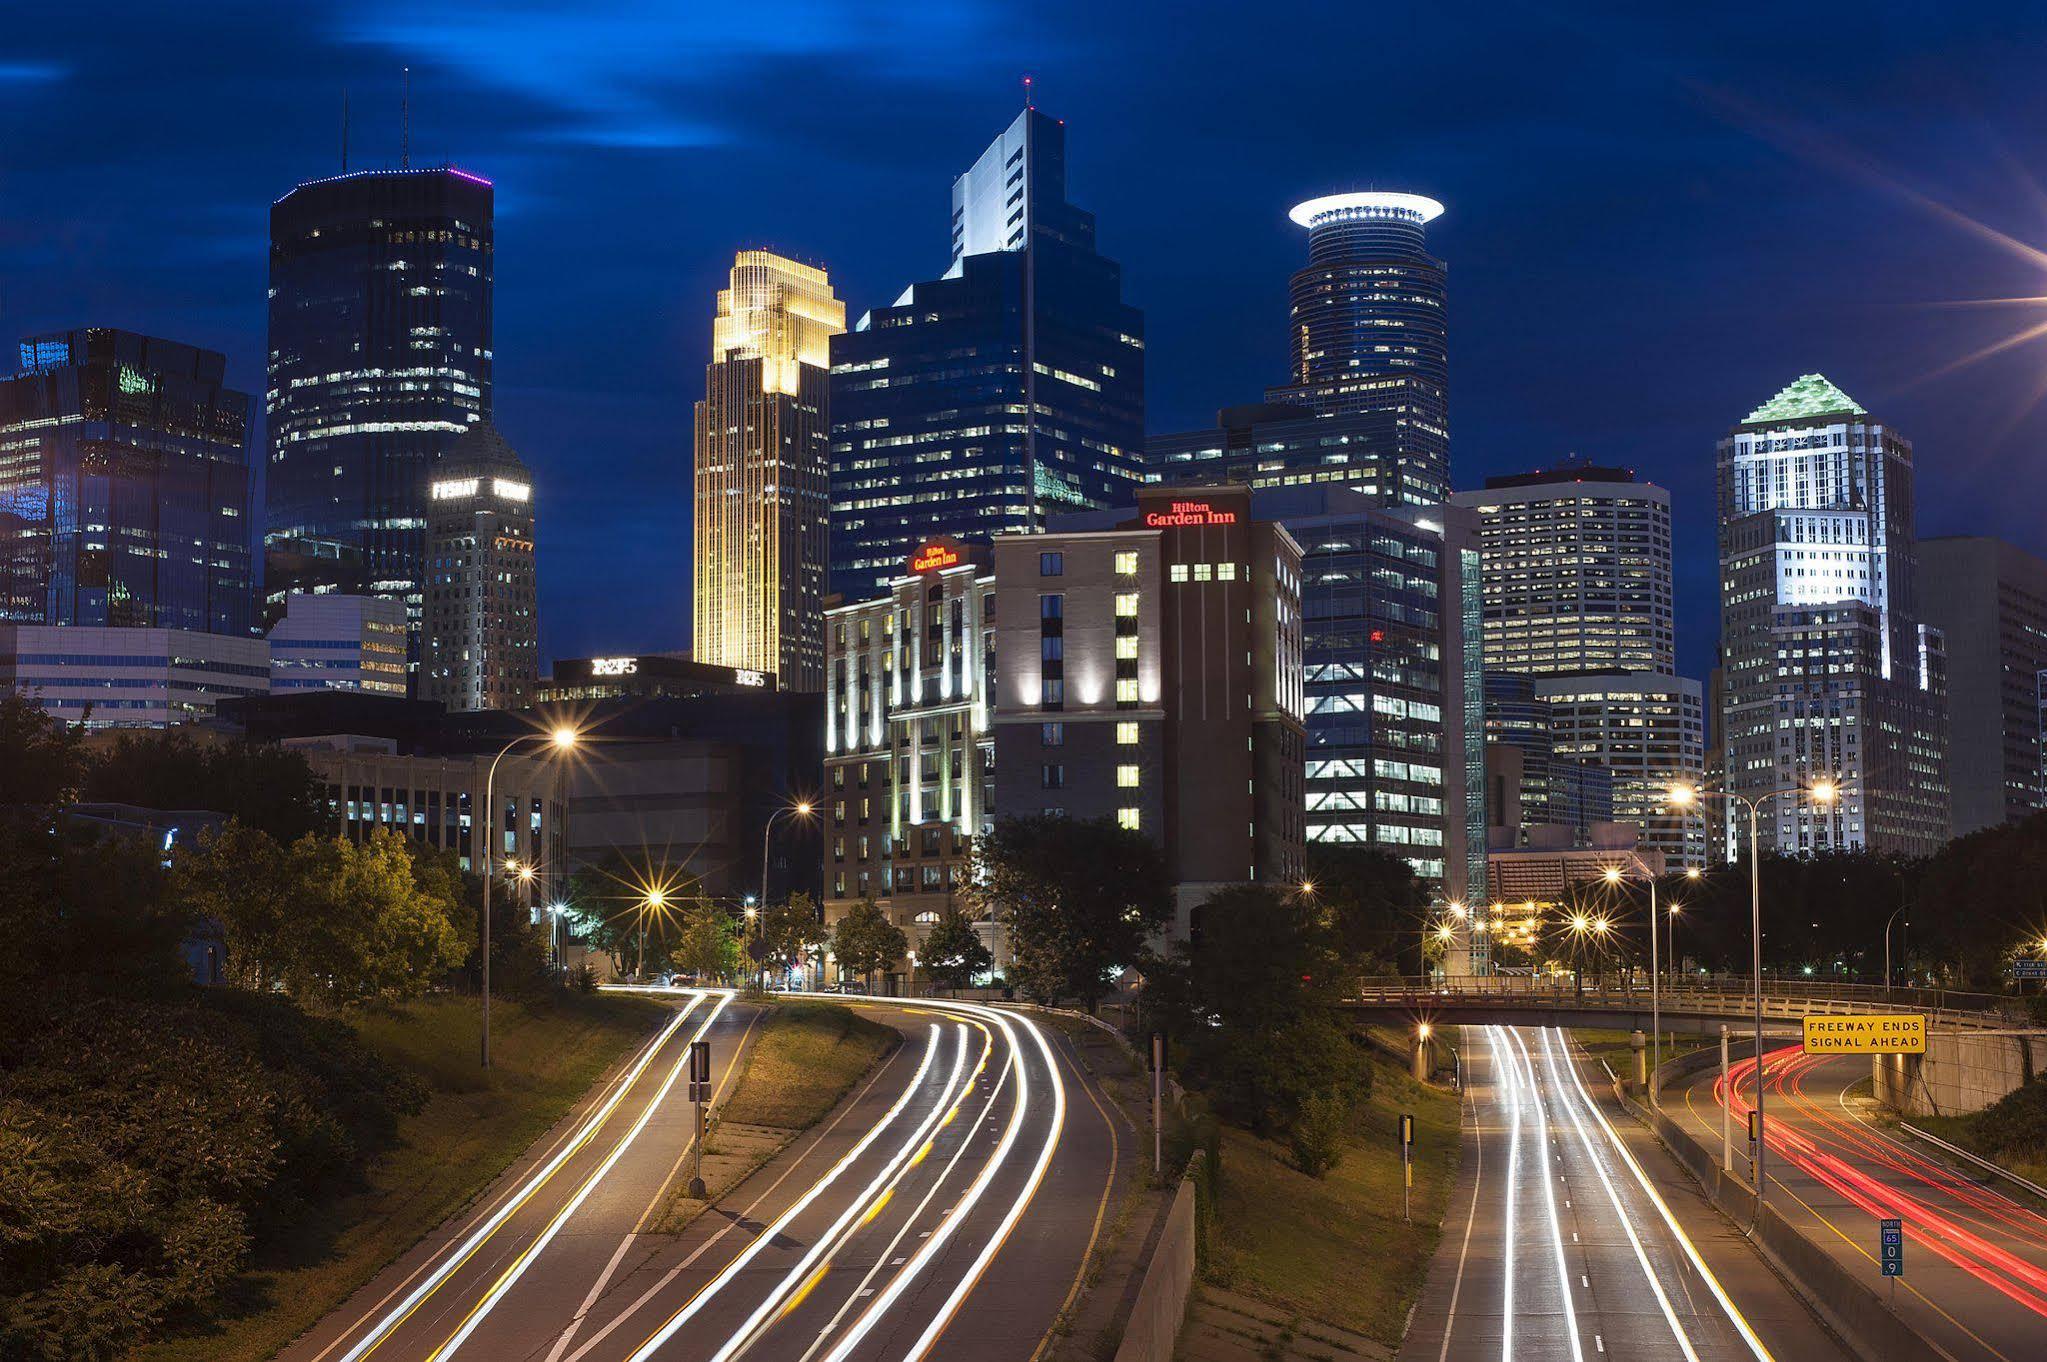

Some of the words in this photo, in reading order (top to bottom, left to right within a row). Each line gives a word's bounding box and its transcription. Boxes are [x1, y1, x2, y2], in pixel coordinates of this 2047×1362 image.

[1171, 502, 1210, 513] Hilton
[1146, 512, 1204, 526] Garden
[1207, 511, 1236, 524] Inn
[1809, 1022, 1875, 1031] FREEWAY
[1883, 1022, 1919, 1031] ENDS
[1811, 1038, 1862, 1047] SIGNAL
[1870, 1037, 1919, 1047] AHEAD
[1886, 1234, 1898, 1242] 65
[1887, 1246, 1896, 1258] 0
